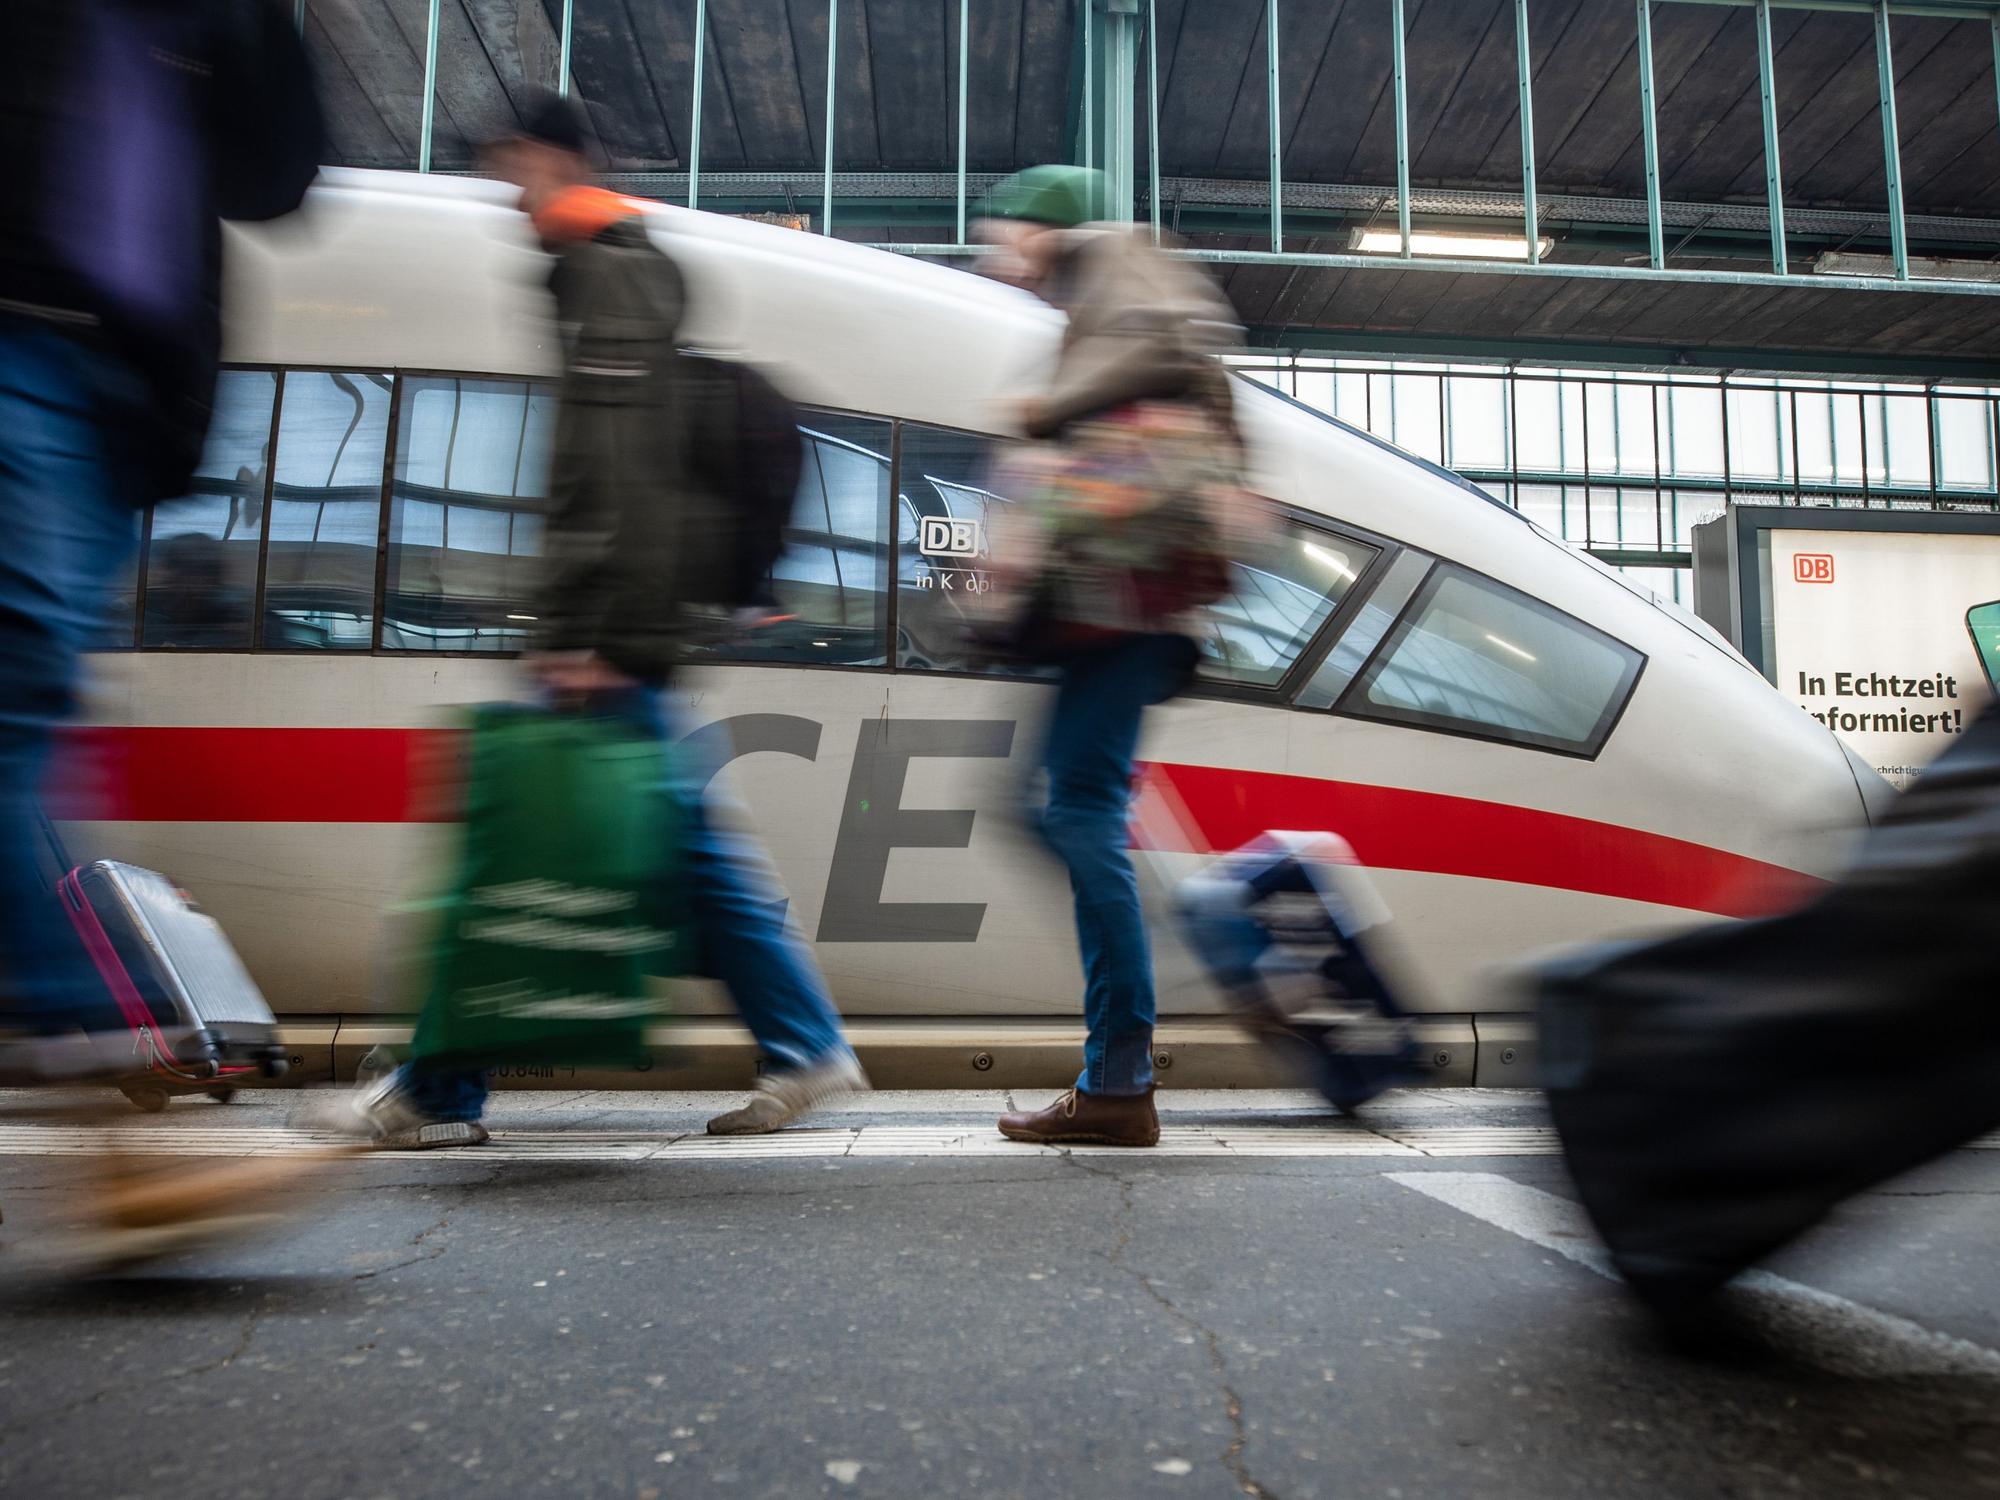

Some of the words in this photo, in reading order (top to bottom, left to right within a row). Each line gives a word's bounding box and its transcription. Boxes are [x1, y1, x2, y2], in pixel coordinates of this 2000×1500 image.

[925, 521, 973, 552] DB
[915, 571, 933, 589] in
[1798, 557, 1831, 580] DB
[1798, 671, 1826, 696] In
[1834, 671, 1958, 698] Echtzeit
[1800, 704, 1962, 734] nformiert!
[1875, 765, 1925, 777] chrichtigu
